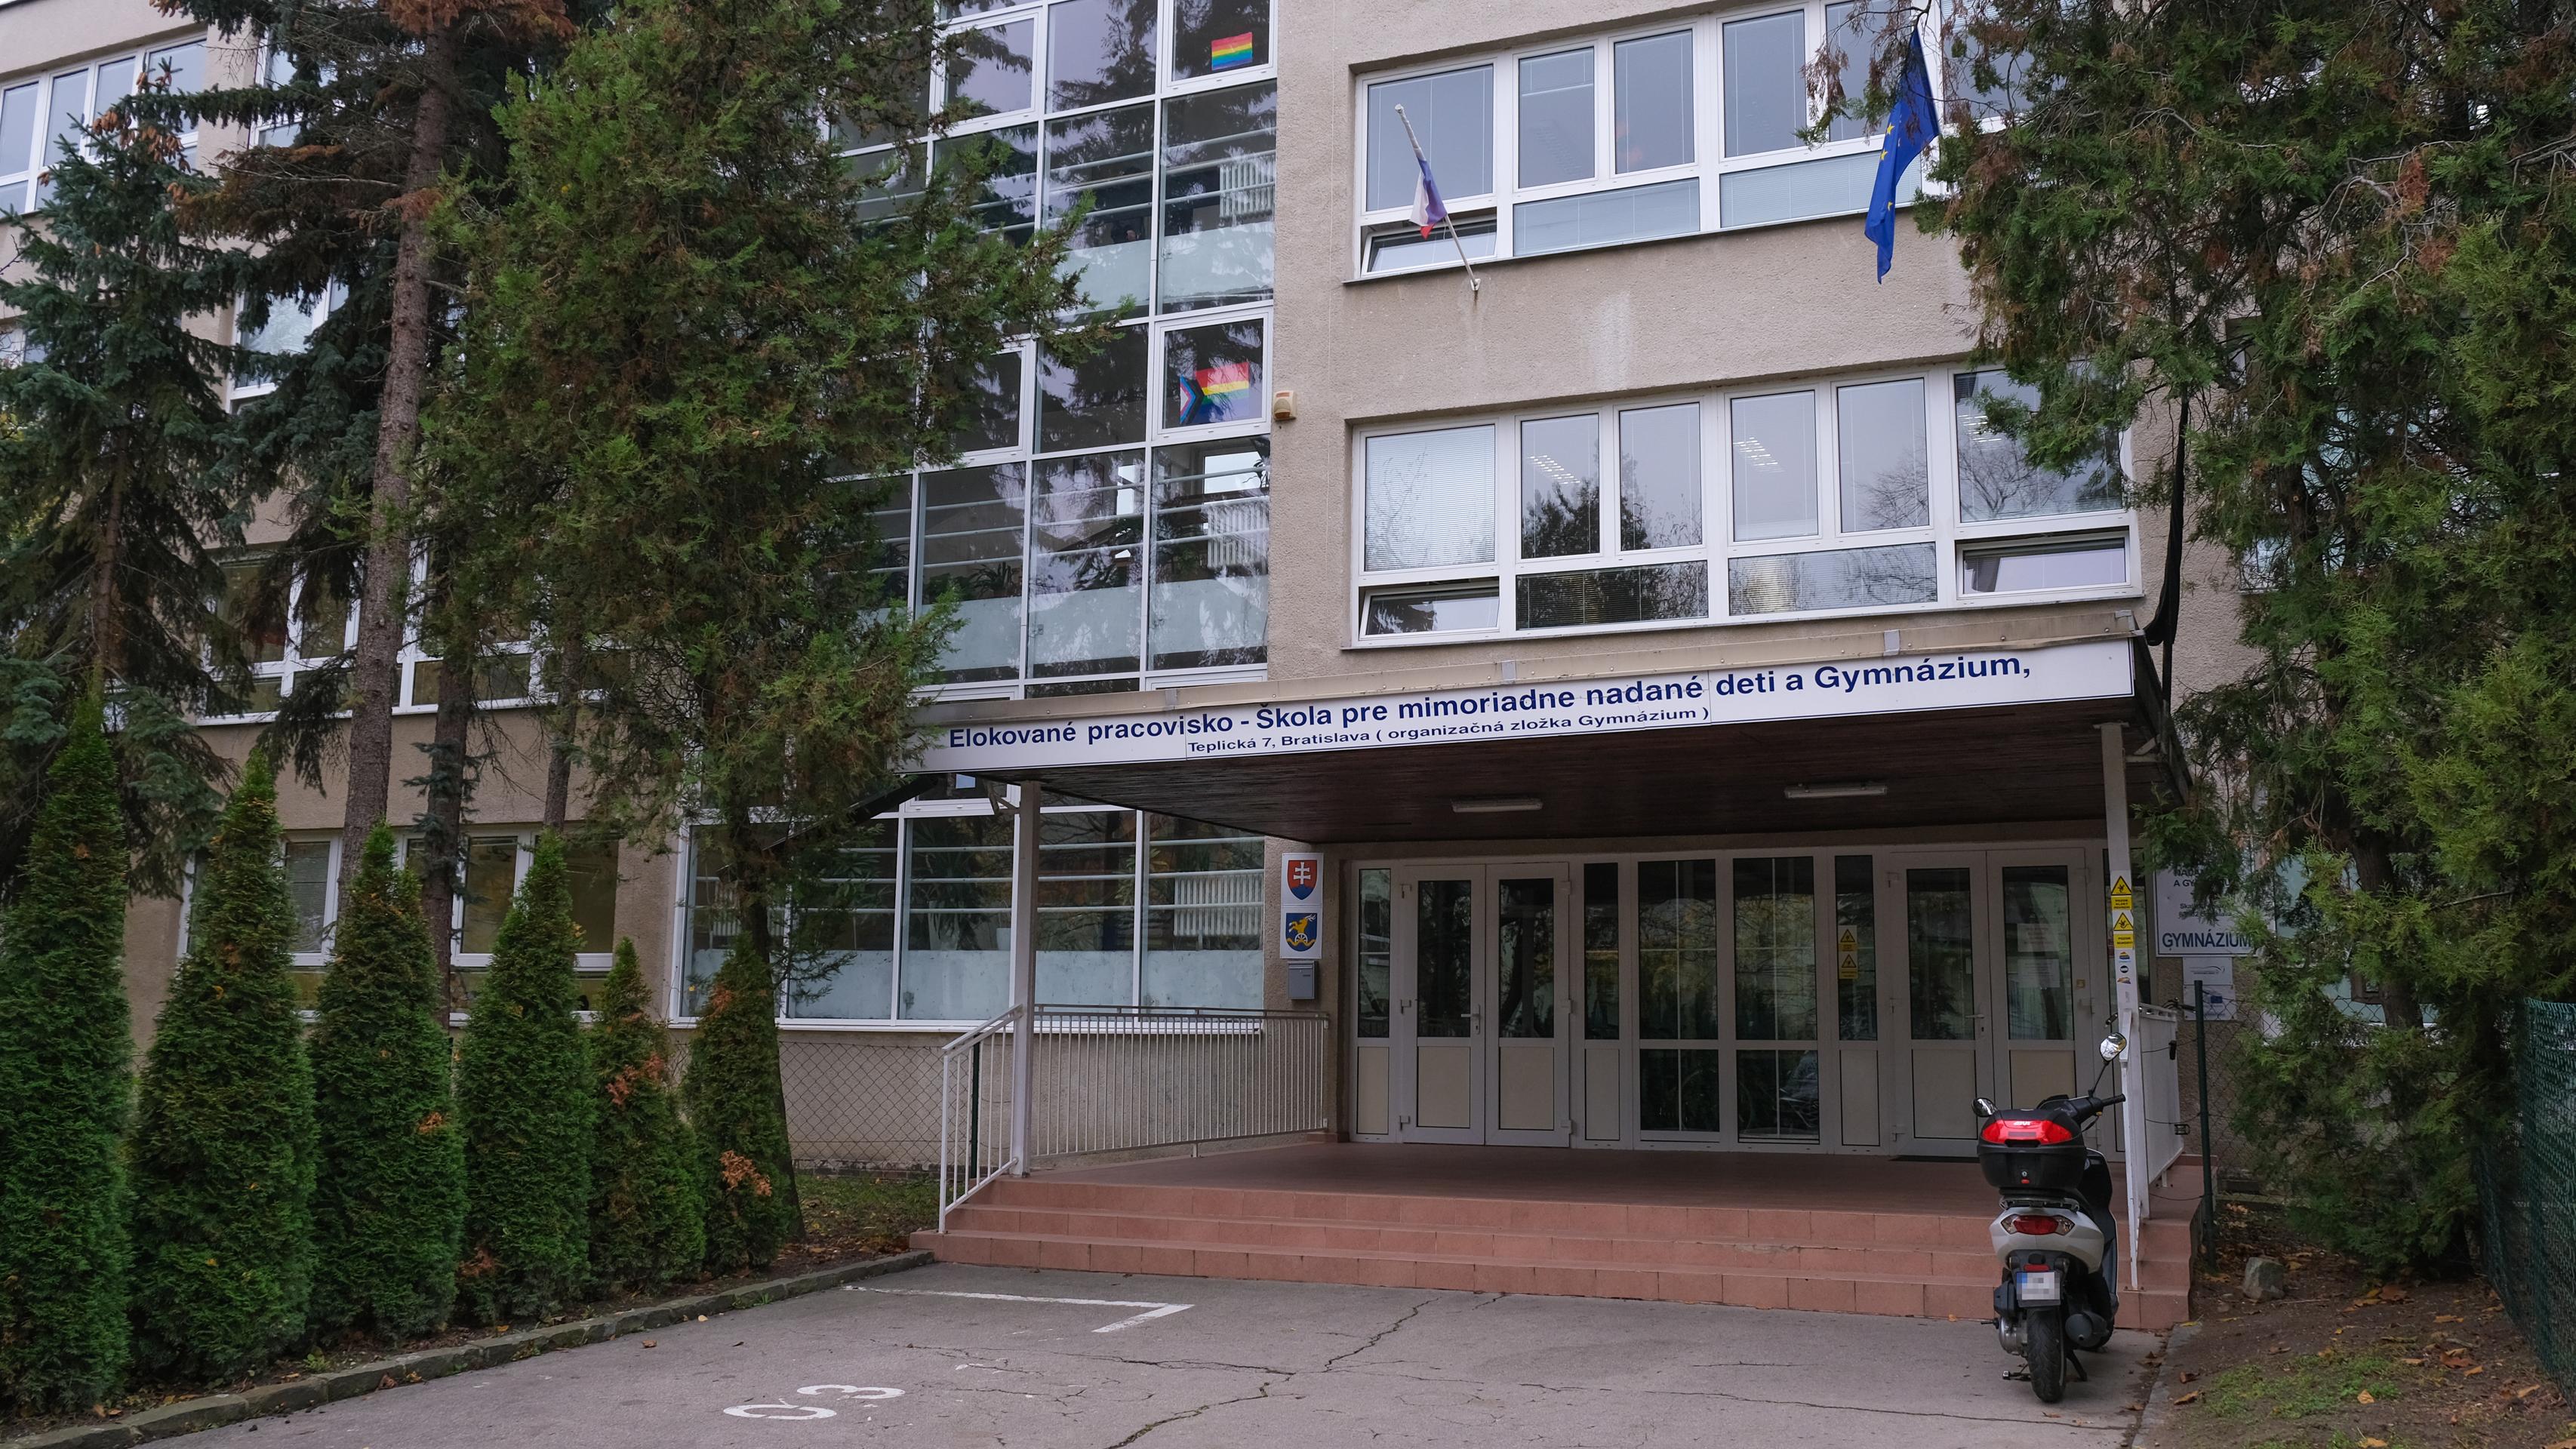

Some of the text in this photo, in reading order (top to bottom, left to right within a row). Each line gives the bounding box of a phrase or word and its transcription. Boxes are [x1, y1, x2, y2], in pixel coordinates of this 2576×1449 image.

[949, 721, 1076, 748] Elokované
[1088, 713, 1233, 746] pracovisko
[1256, 703, 1331, 729] Škola
[1342, 705, 1388, 728] pre
[1399, 689, 1575, 719] mimoriadne
[1587, 675, 1703, 706] nadané
[1716, 671, 1775, 696] deti
[1786, 674, 1804, 691] a
[1814, 657, 2030, 693] Gymnázium,
[1187, 739, 1257, 754] Teplická
[1262, 737, 1276, 749] 7,
[1282, 732, 1370, 746] Bratislava
[1388, 721, 1504, 740] organizačná
[1510, 718, 1571, 731] zložka
[1578, 710, 1696, 728] Gymnázium
[2162, 929, 2251, 948] GYMNÁZIUM
